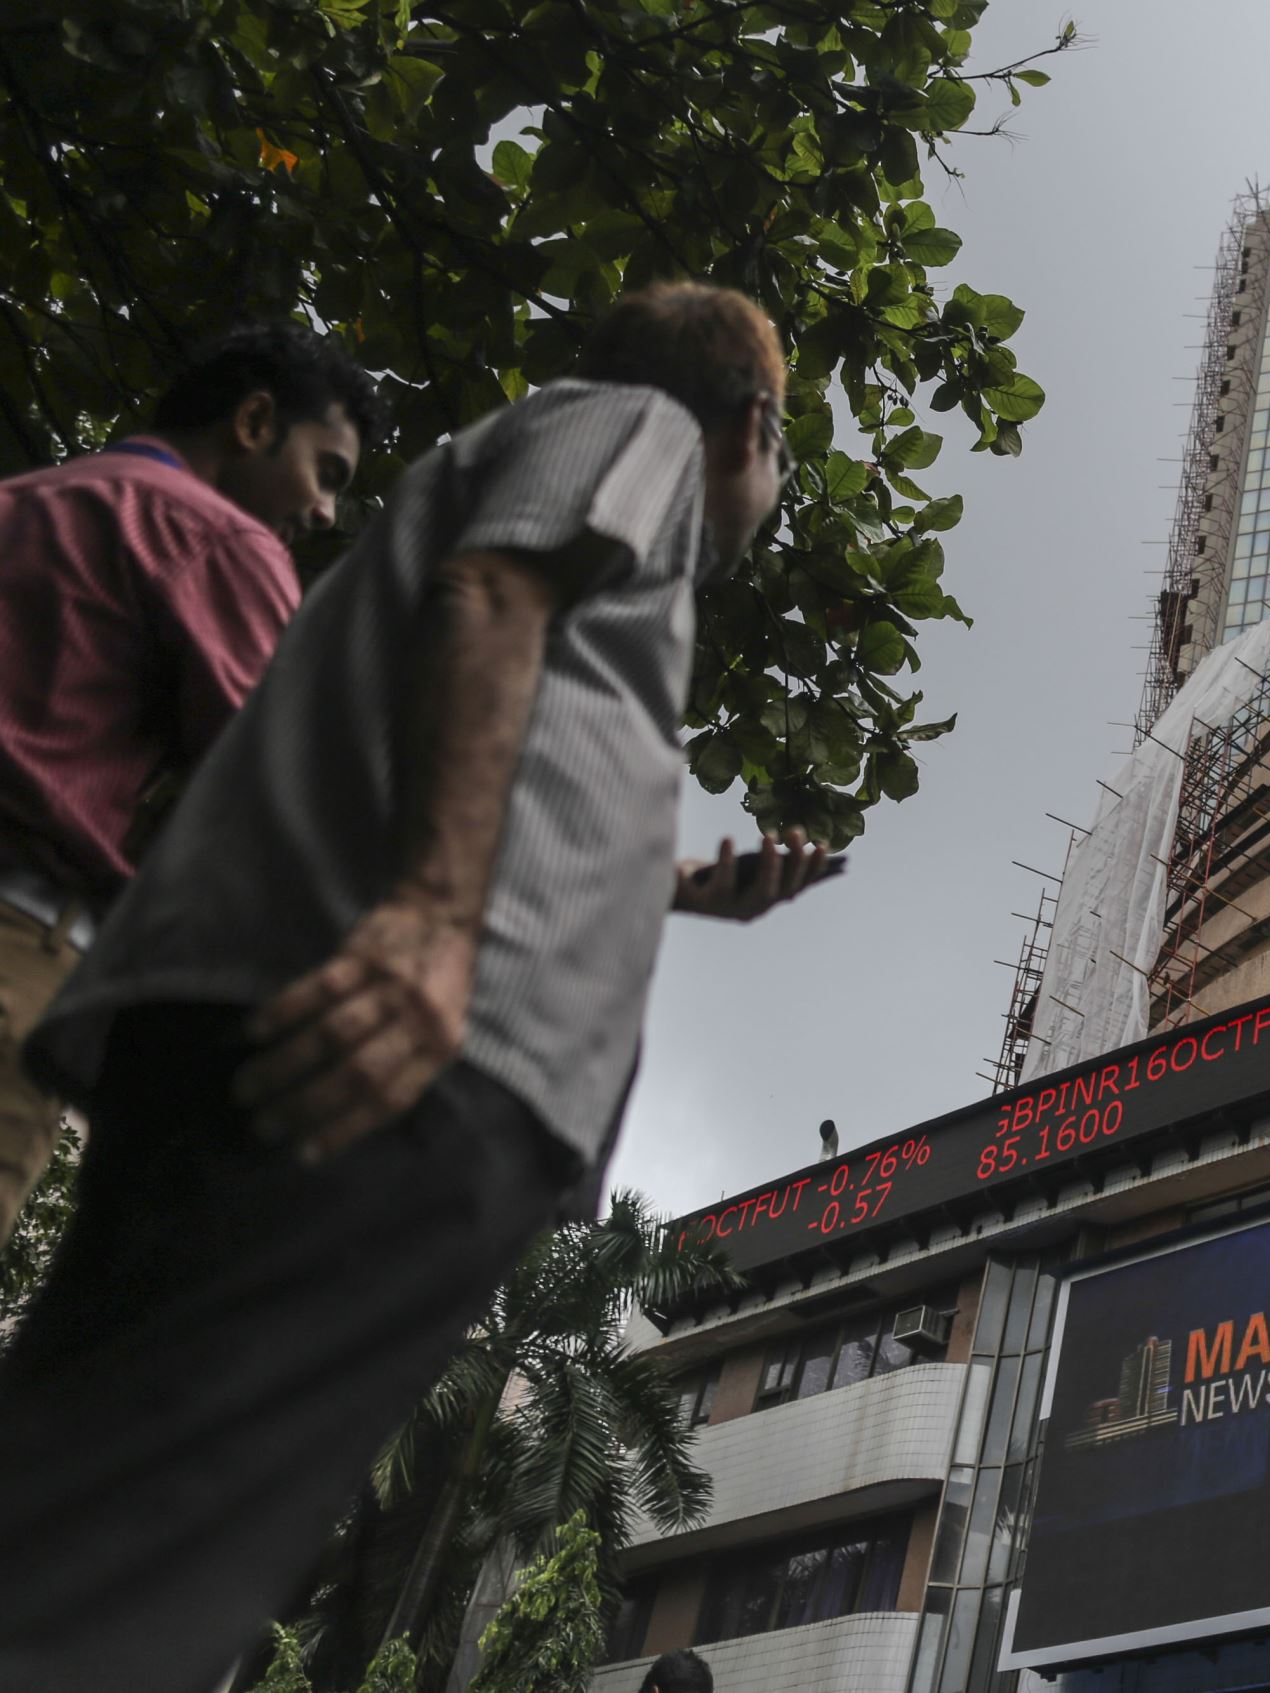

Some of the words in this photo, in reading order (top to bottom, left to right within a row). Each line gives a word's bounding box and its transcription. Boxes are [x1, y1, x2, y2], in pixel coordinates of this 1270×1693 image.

[976, 1100, 1124, 1179] 85.1600
[678, 1178, 811, 1251] OCTFUT
[817, 1135, 931, 1196] -0.76%
[807, 1181, 892, 1234] -0.57
